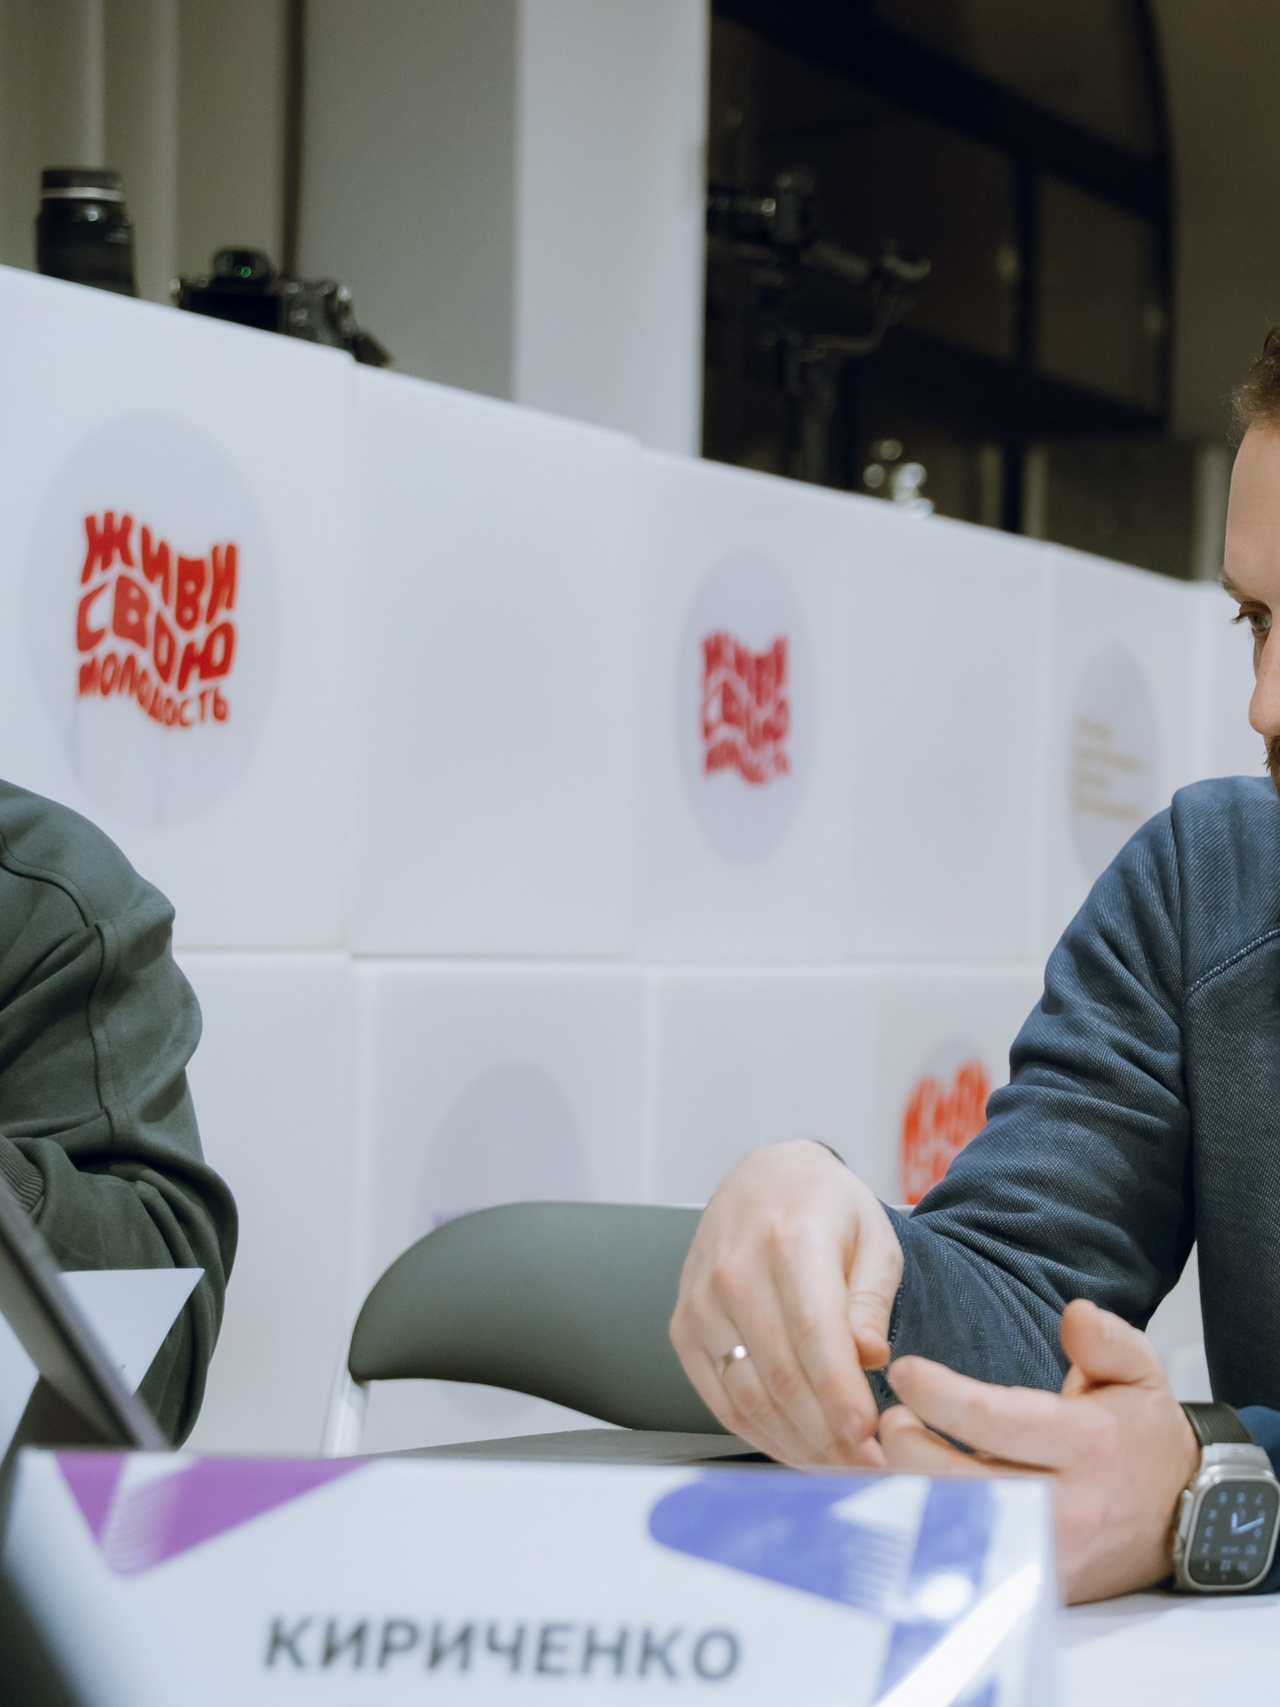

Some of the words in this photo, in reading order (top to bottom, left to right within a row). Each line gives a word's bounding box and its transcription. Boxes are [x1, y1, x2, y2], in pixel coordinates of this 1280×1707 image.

[80, 510, 237, 632] ЖИВИ
[75, 573, 236, 693] СВОЮ
[77, 652, 229, 729] МОЛОДОСТЬ
[264, 1614, 742, 1681] КИРИЧЕНКО
